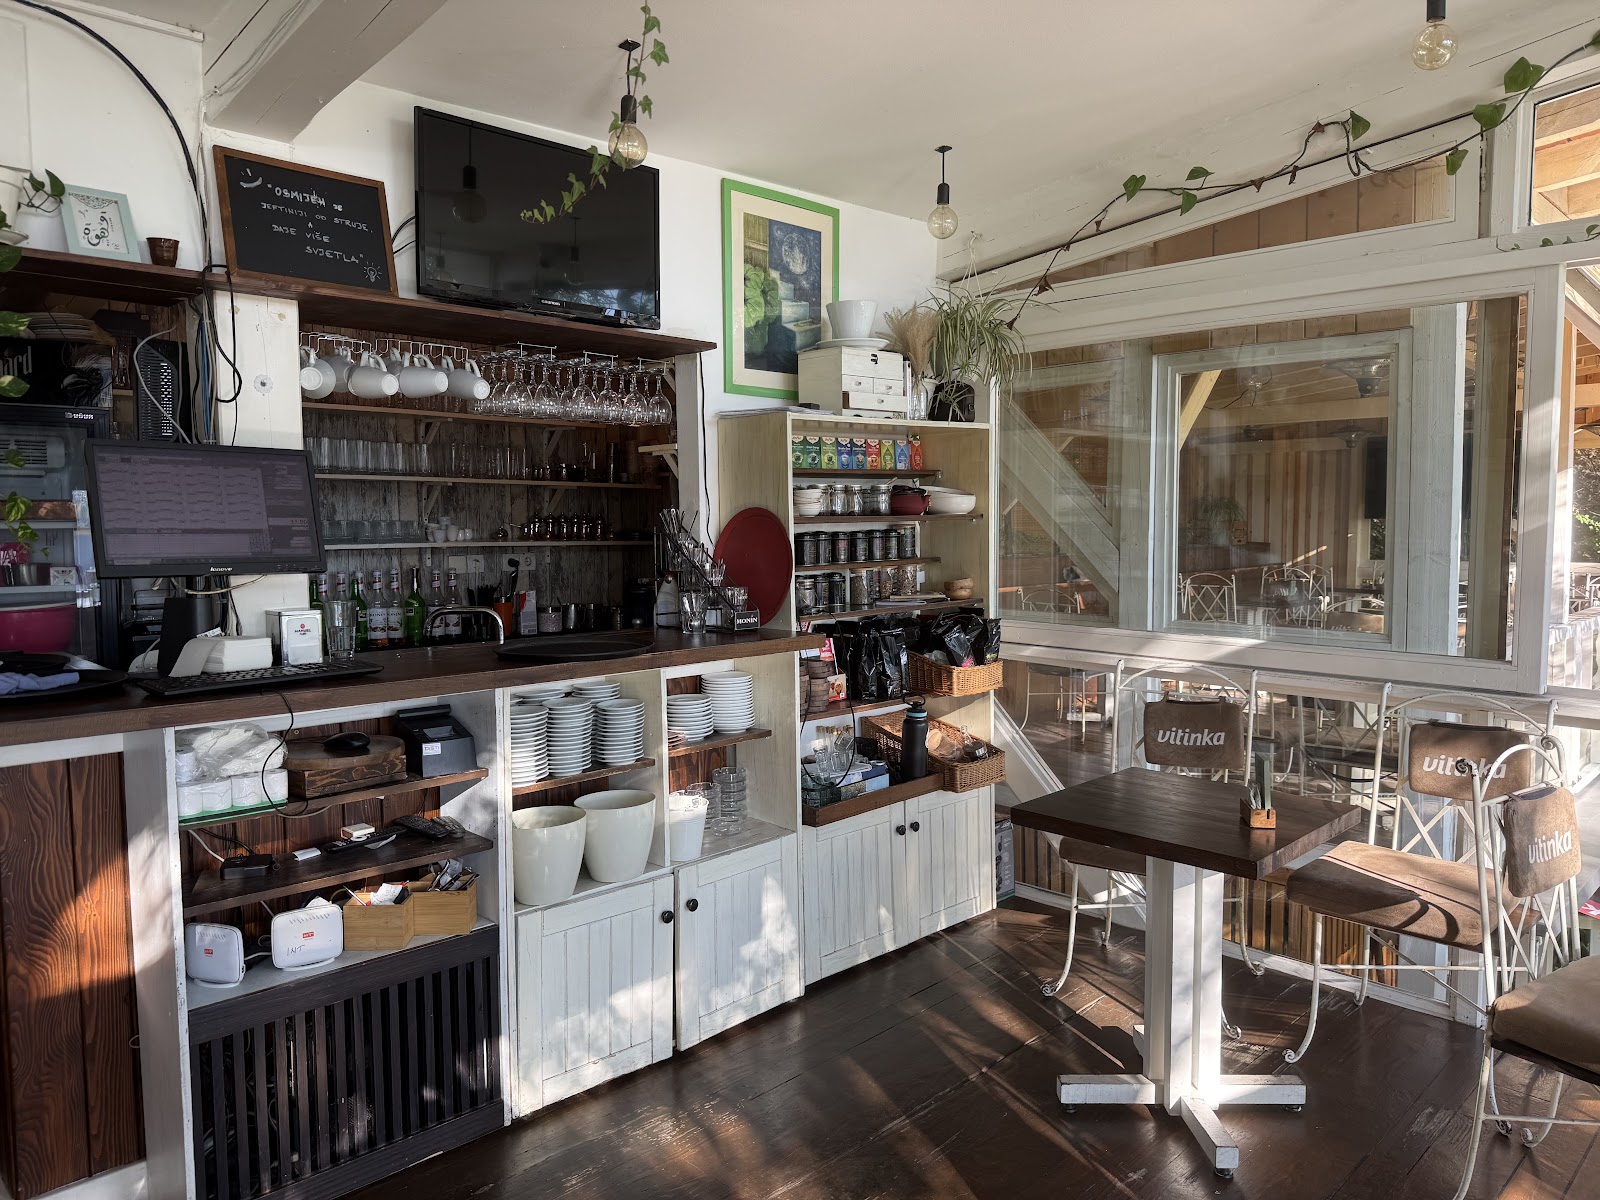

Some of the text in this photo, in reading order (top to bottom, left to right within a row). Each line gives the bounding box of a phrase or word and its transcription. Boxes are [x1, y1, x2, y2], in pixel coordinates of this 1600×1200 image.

[260, 202, 308, 217] JEFTINIJI
[271, 224, 330, 243] DAJE VIŠE
[736, 614, 758, 624] MONIN
[1157, 726, 1226, 746] vitinka
[1422, 754, 1507, 779] vitka
[1528, 830, 1572, 864] vitinka
